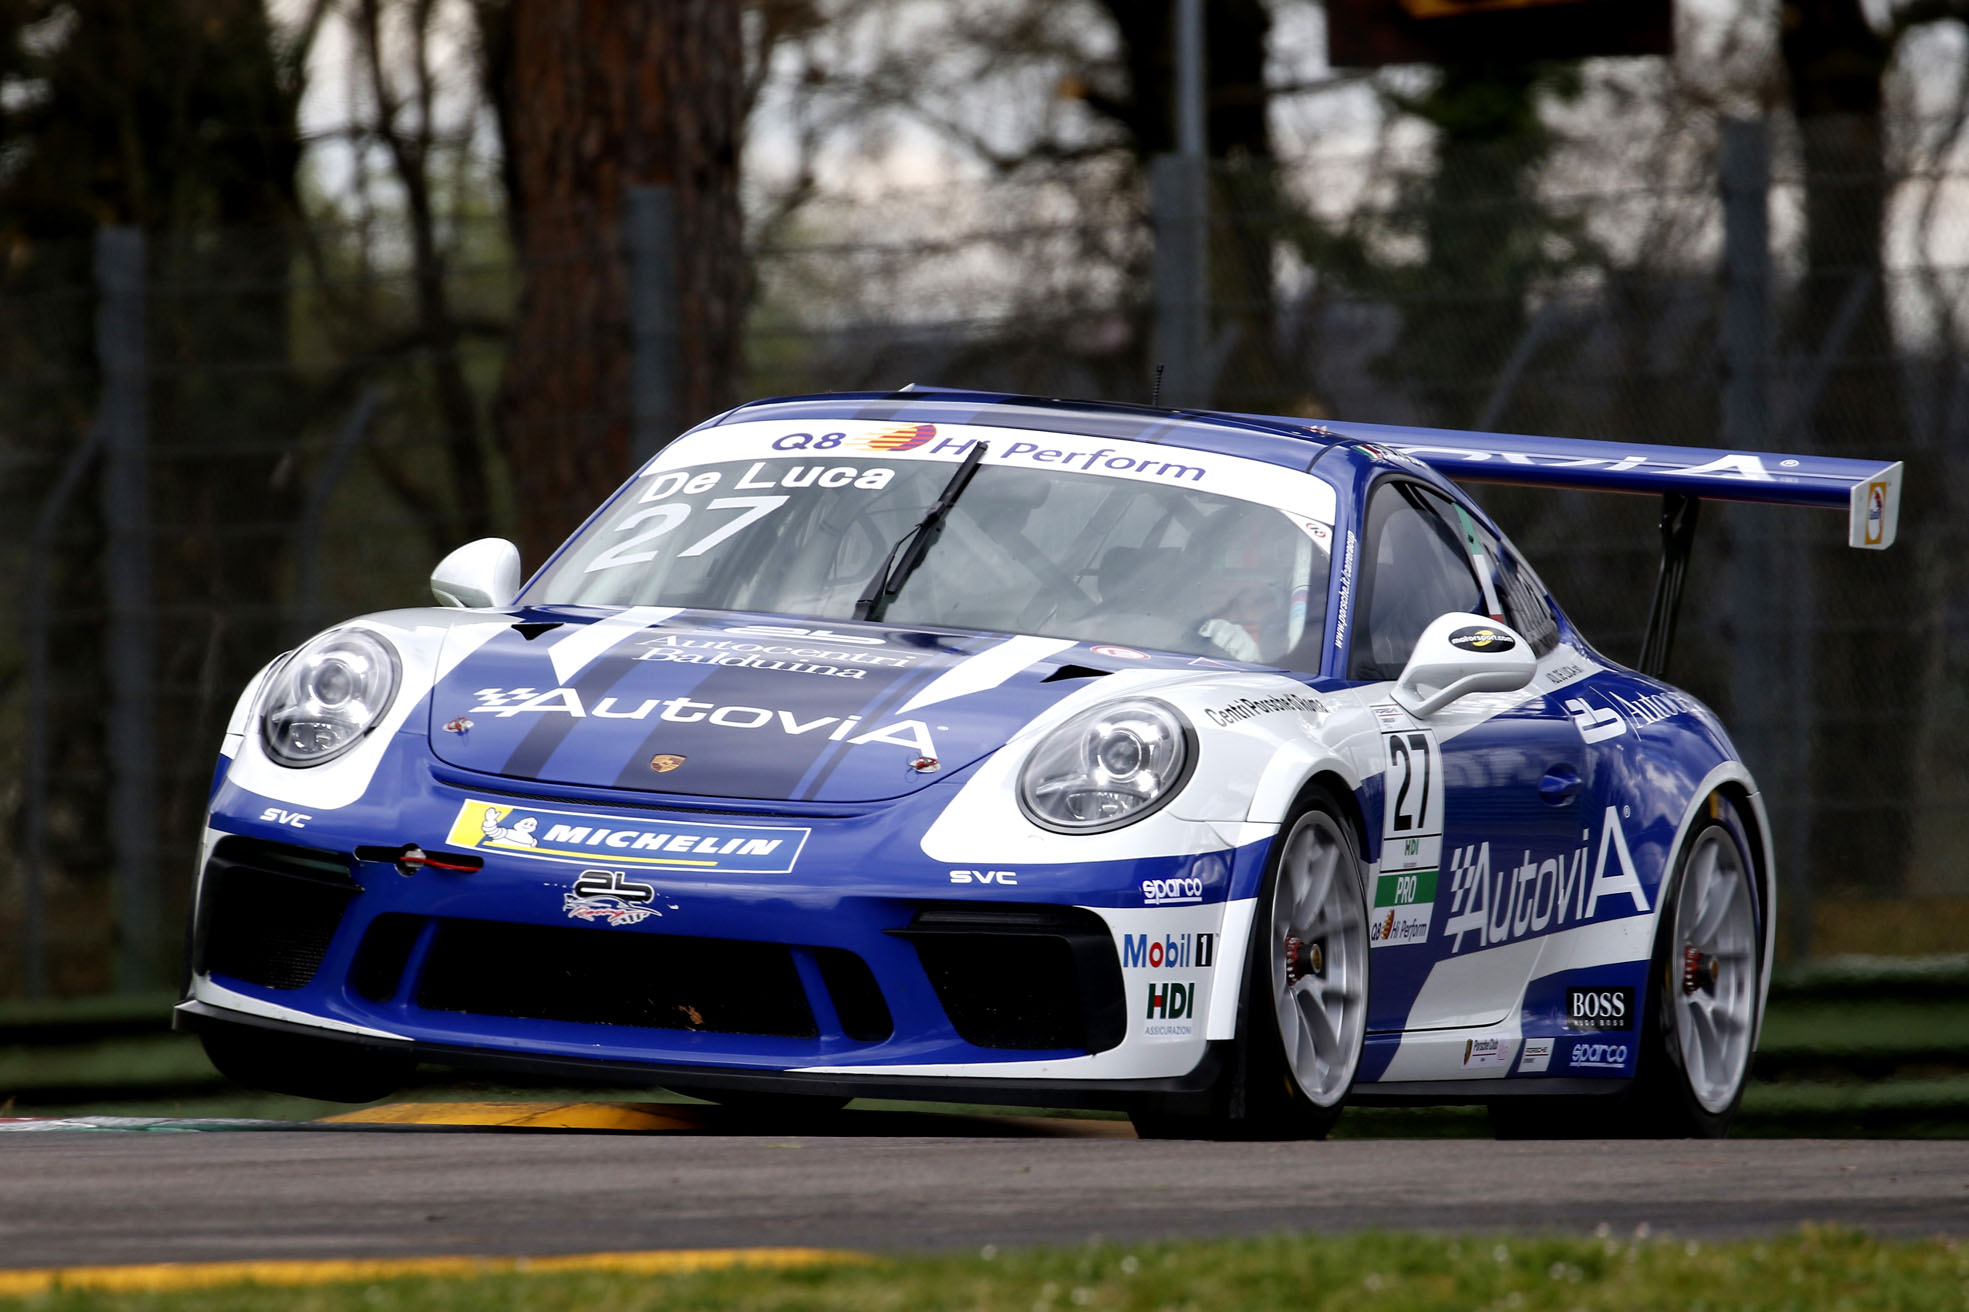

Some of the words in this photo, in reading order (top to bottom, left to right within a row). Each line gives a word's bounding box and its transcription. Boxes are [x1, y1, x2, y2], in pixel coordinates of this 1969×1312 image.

[771, 432, 846, 452] Q8
[1000, 442, 1206, 481] Perform
[639, 472, 716, 504] De
[735, 462, 895, 490] Luca
[584, 495, 790, 573] 27
[633, 635, 916, 667] Autocentri
[1451, 634, 1514, 645] motorsport.com
[631, 647, 868, 680] Balduina
[1204, 700, 1253, 727] Centri
[1390, 733, 1430, 831] 27
[260, 808, 312, 828] SVC
[543, 823, 784, 856] MICHELIN
[1405, 839, 1419, 856] HDI
[950, 870, 1017, 885] SVC
[1143, 876, 1202, 904] sparco
[1395, 875, 1417, 904] PRO
[1371, 923, 1381, 941] Q8
[1400, 919, 1427, 942] Perform
[1123, 934, 1190, 968] Mobil
[1146, 983, 1194, 1019] HDI
[1572, 992, 1625, 1017] BOSS
[1145, 1026, 1192, 1036] ASSICURAZIONI
[1571, 1043, 1628, 1068] sparco
